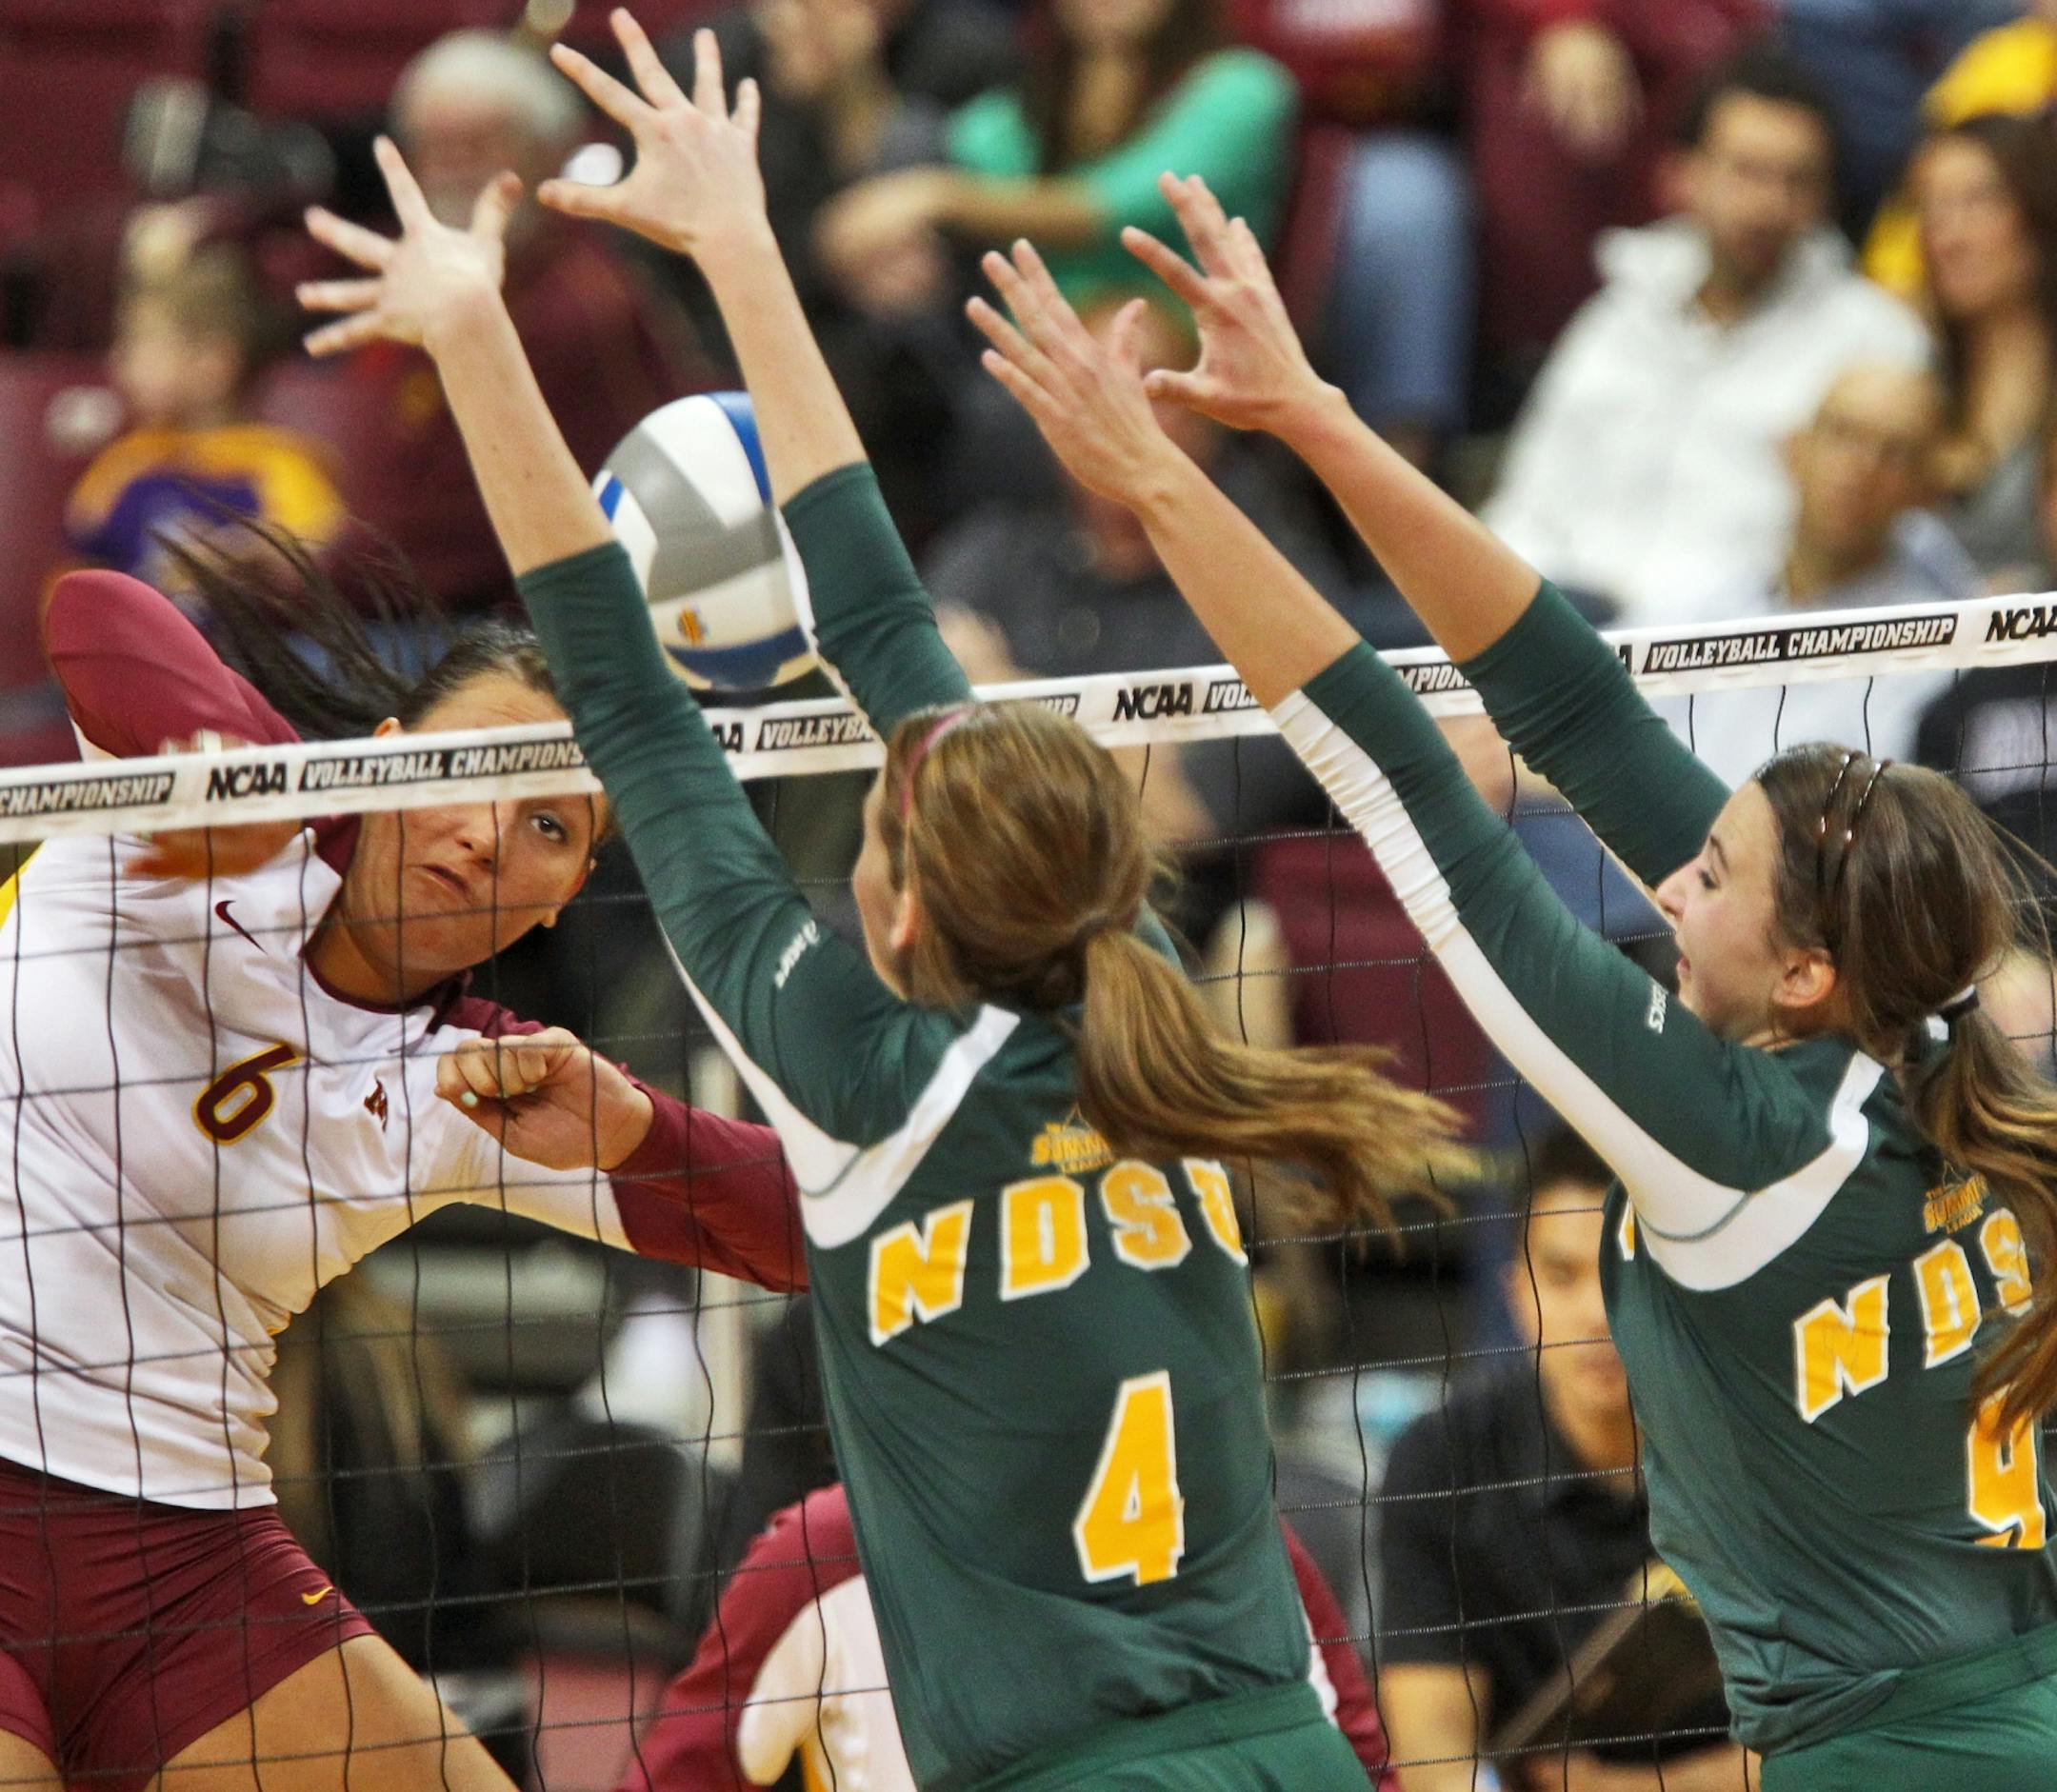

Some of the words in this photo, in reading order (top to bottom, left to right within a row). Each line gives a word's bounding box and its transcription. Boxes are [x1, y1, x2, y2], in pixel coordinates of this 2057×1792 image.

[1650, 633, 1780, 670] VOLLEYBALL
[1787, 617, 1955, 657] CHAMPIONSHIP
[1112, 682, 1193, 722] NCAA
[207, 763, 288, 802] NCAA
[306, 750, 444, 789] VOLLEYBALL
[192, 1041, 302, 1146] 6
[1072, 1369, 1186, 1586] 4
